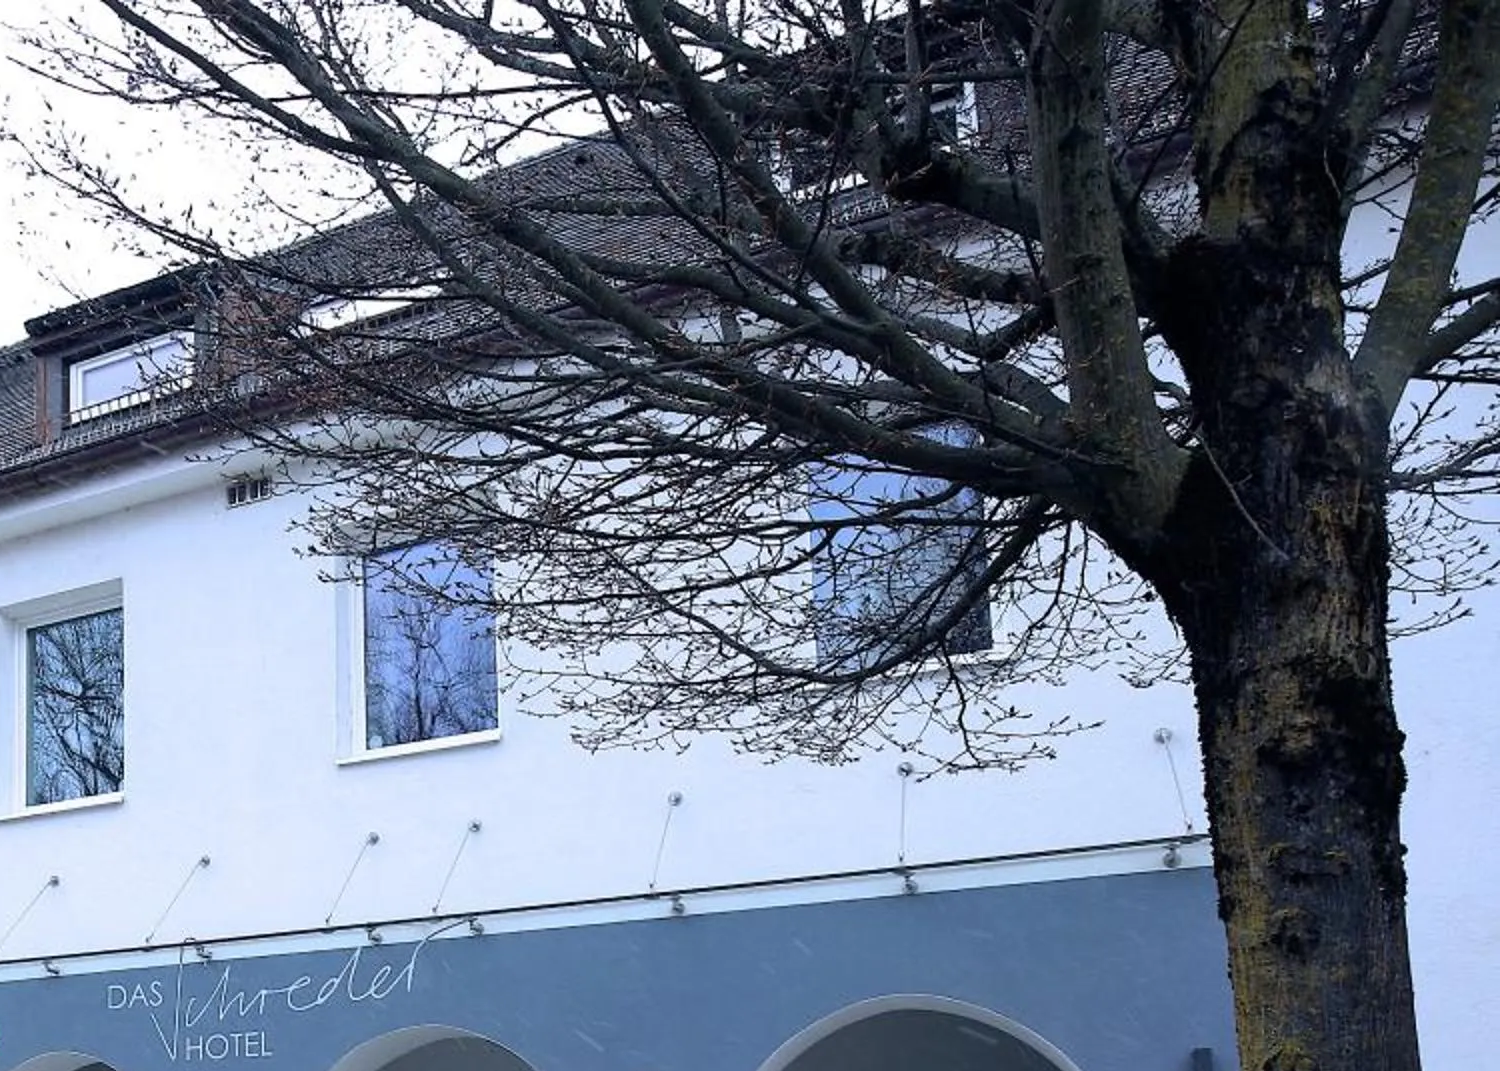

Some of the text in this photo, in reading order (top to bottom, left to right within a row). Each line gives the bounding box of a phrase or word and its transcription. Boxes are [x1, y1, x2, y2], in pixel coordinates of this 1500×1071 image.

[107, 917, 477, 1061] DAS Schreder
[185, 1031, 273, 1061] HOTEL
